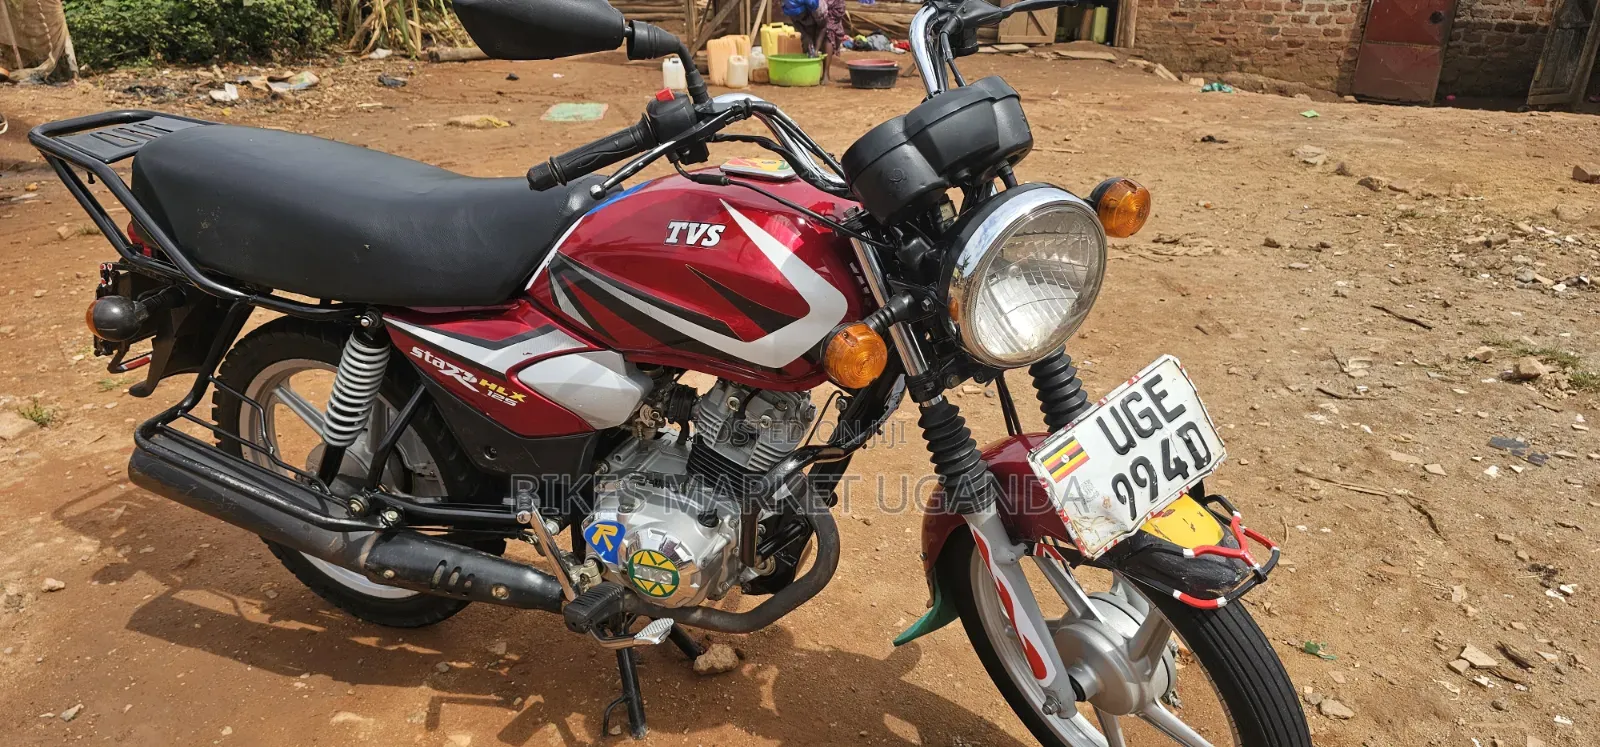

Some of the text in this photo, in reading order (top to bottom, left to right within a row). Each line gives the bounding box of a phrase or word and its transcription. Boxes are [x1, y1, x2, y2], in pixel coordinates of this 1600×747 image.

[664, 220, 727, 247] TVS
[479, 379, 527, 403] HLX
[487, 389, 518, 407] 125
[1096, 373, 1186, 456] UGE
[1111, 421, 1212, 521] 994D
[591, 523, 618, 552] R
